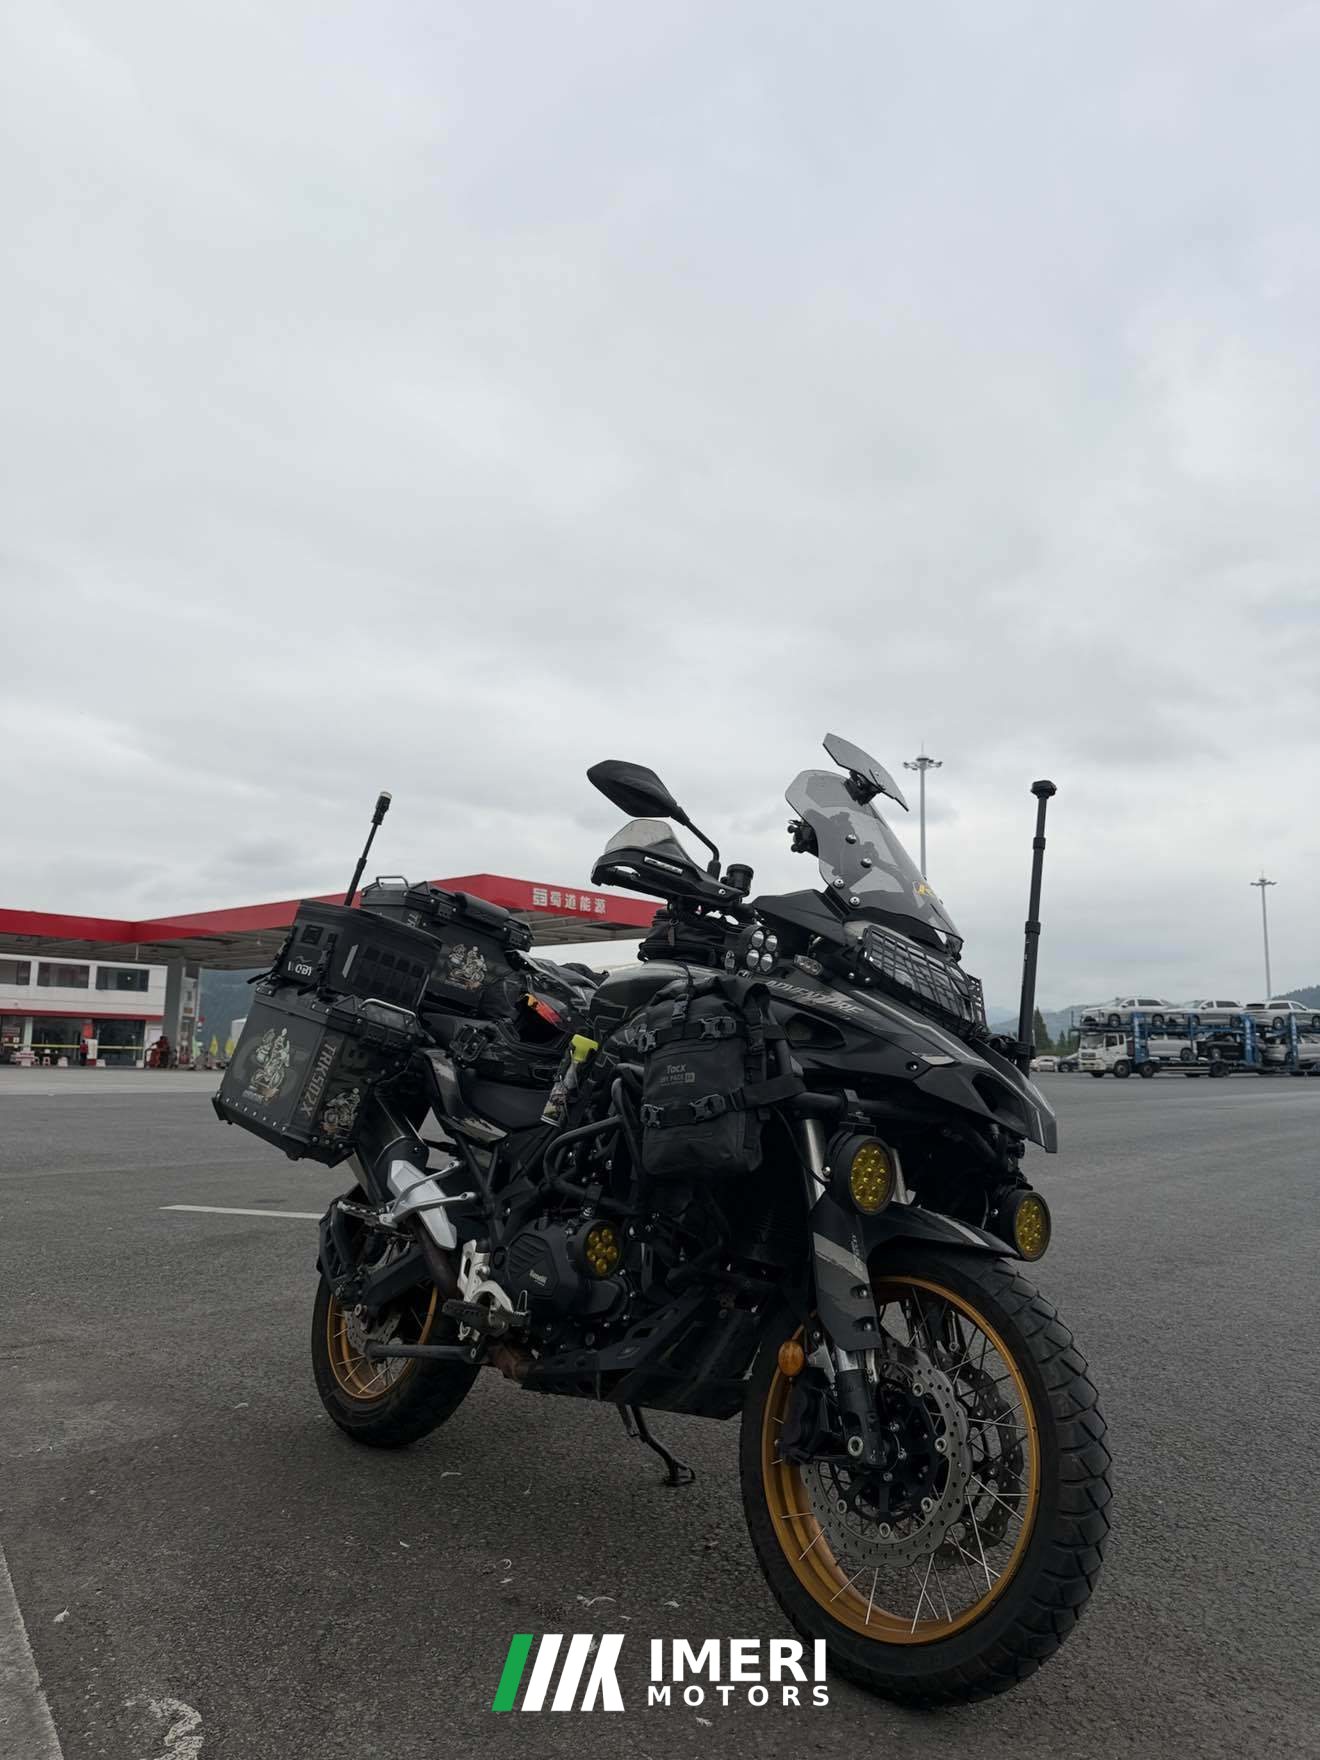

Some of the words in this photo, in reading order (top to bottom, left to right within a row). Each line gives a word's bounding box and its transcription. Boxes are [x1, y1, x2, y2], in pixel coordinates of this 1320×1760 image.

[550, 891, 607, 914] 蜀道能源
[301, 1043, 337, 1117] TRK502X
